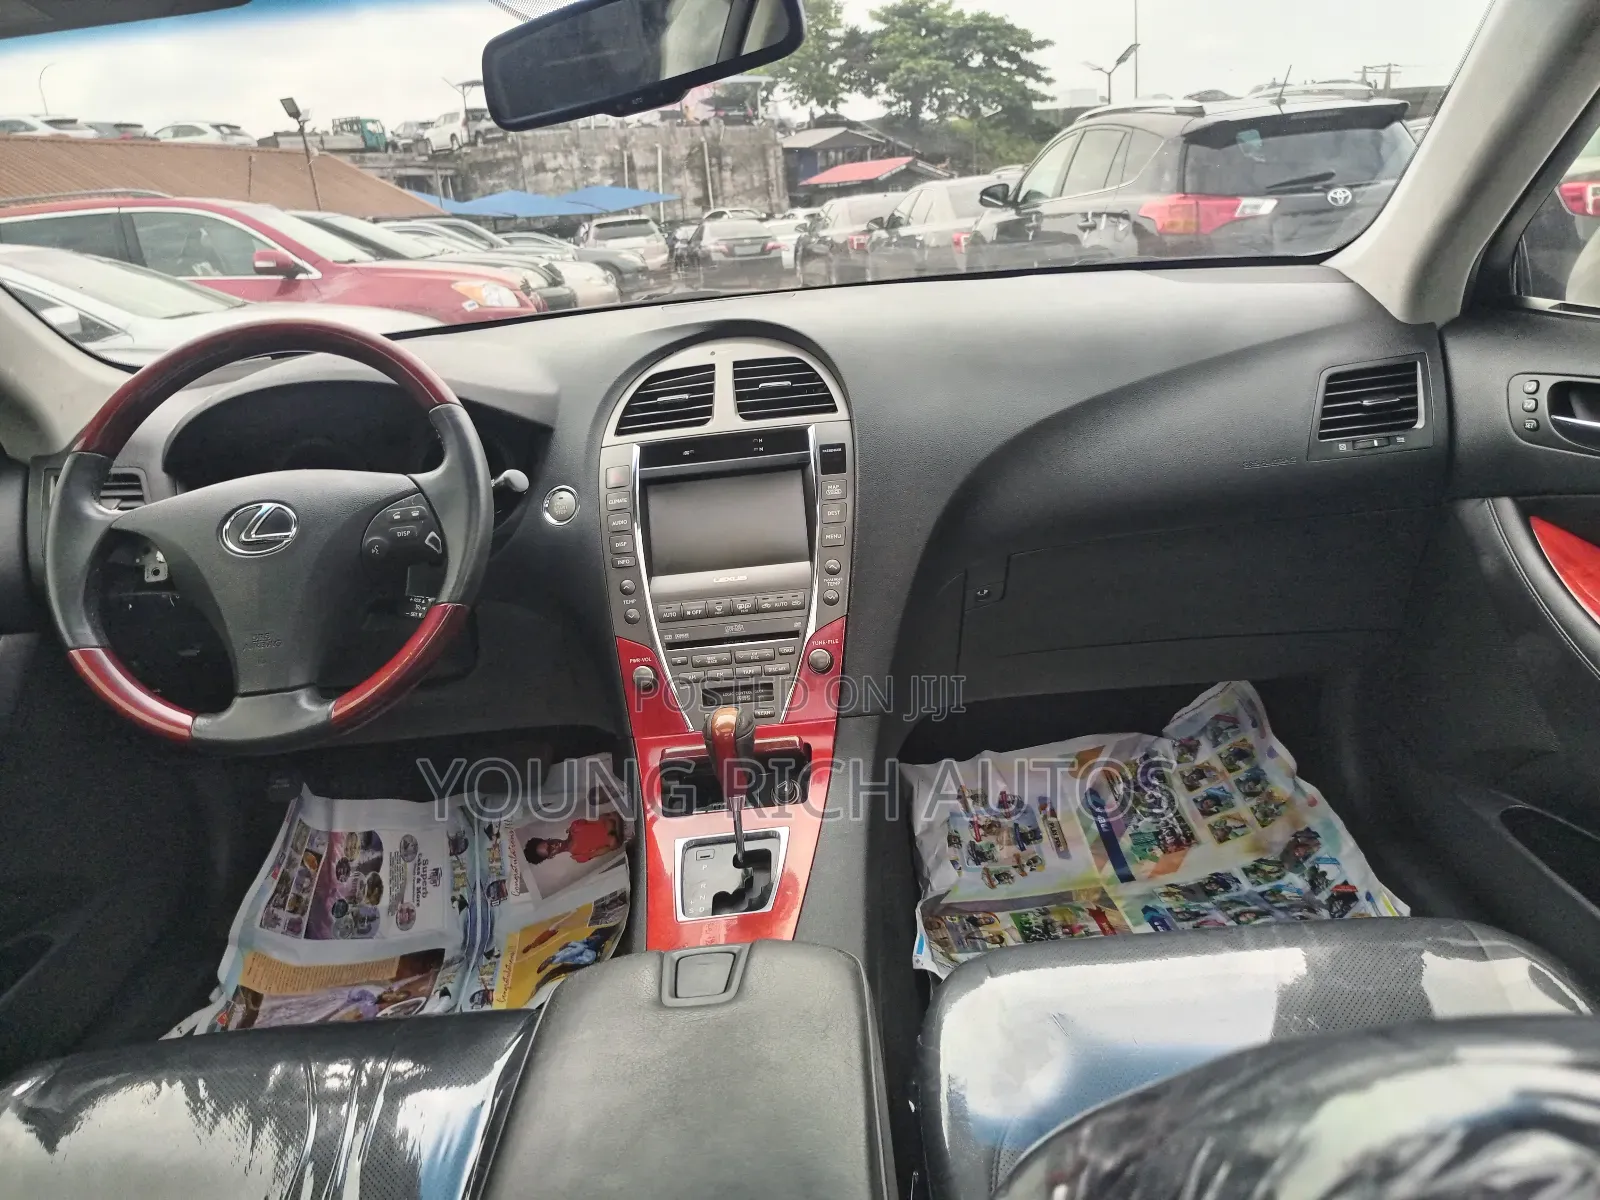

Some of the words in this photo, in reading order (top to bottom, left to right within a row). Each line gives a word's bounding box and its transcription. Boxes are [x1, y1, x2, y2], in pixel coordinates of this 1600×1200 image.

[827, 509, 840, 517] DEST
[612, 518, 628, 527] AUDIO
[396, 529, 411, 537] DISP
[615, 540, 628, 548] DISP
[713, 575, 748, 583] LEXUS
[774, 600, 788, 608] AUTO
[421, 858, 429, 899] Superb
